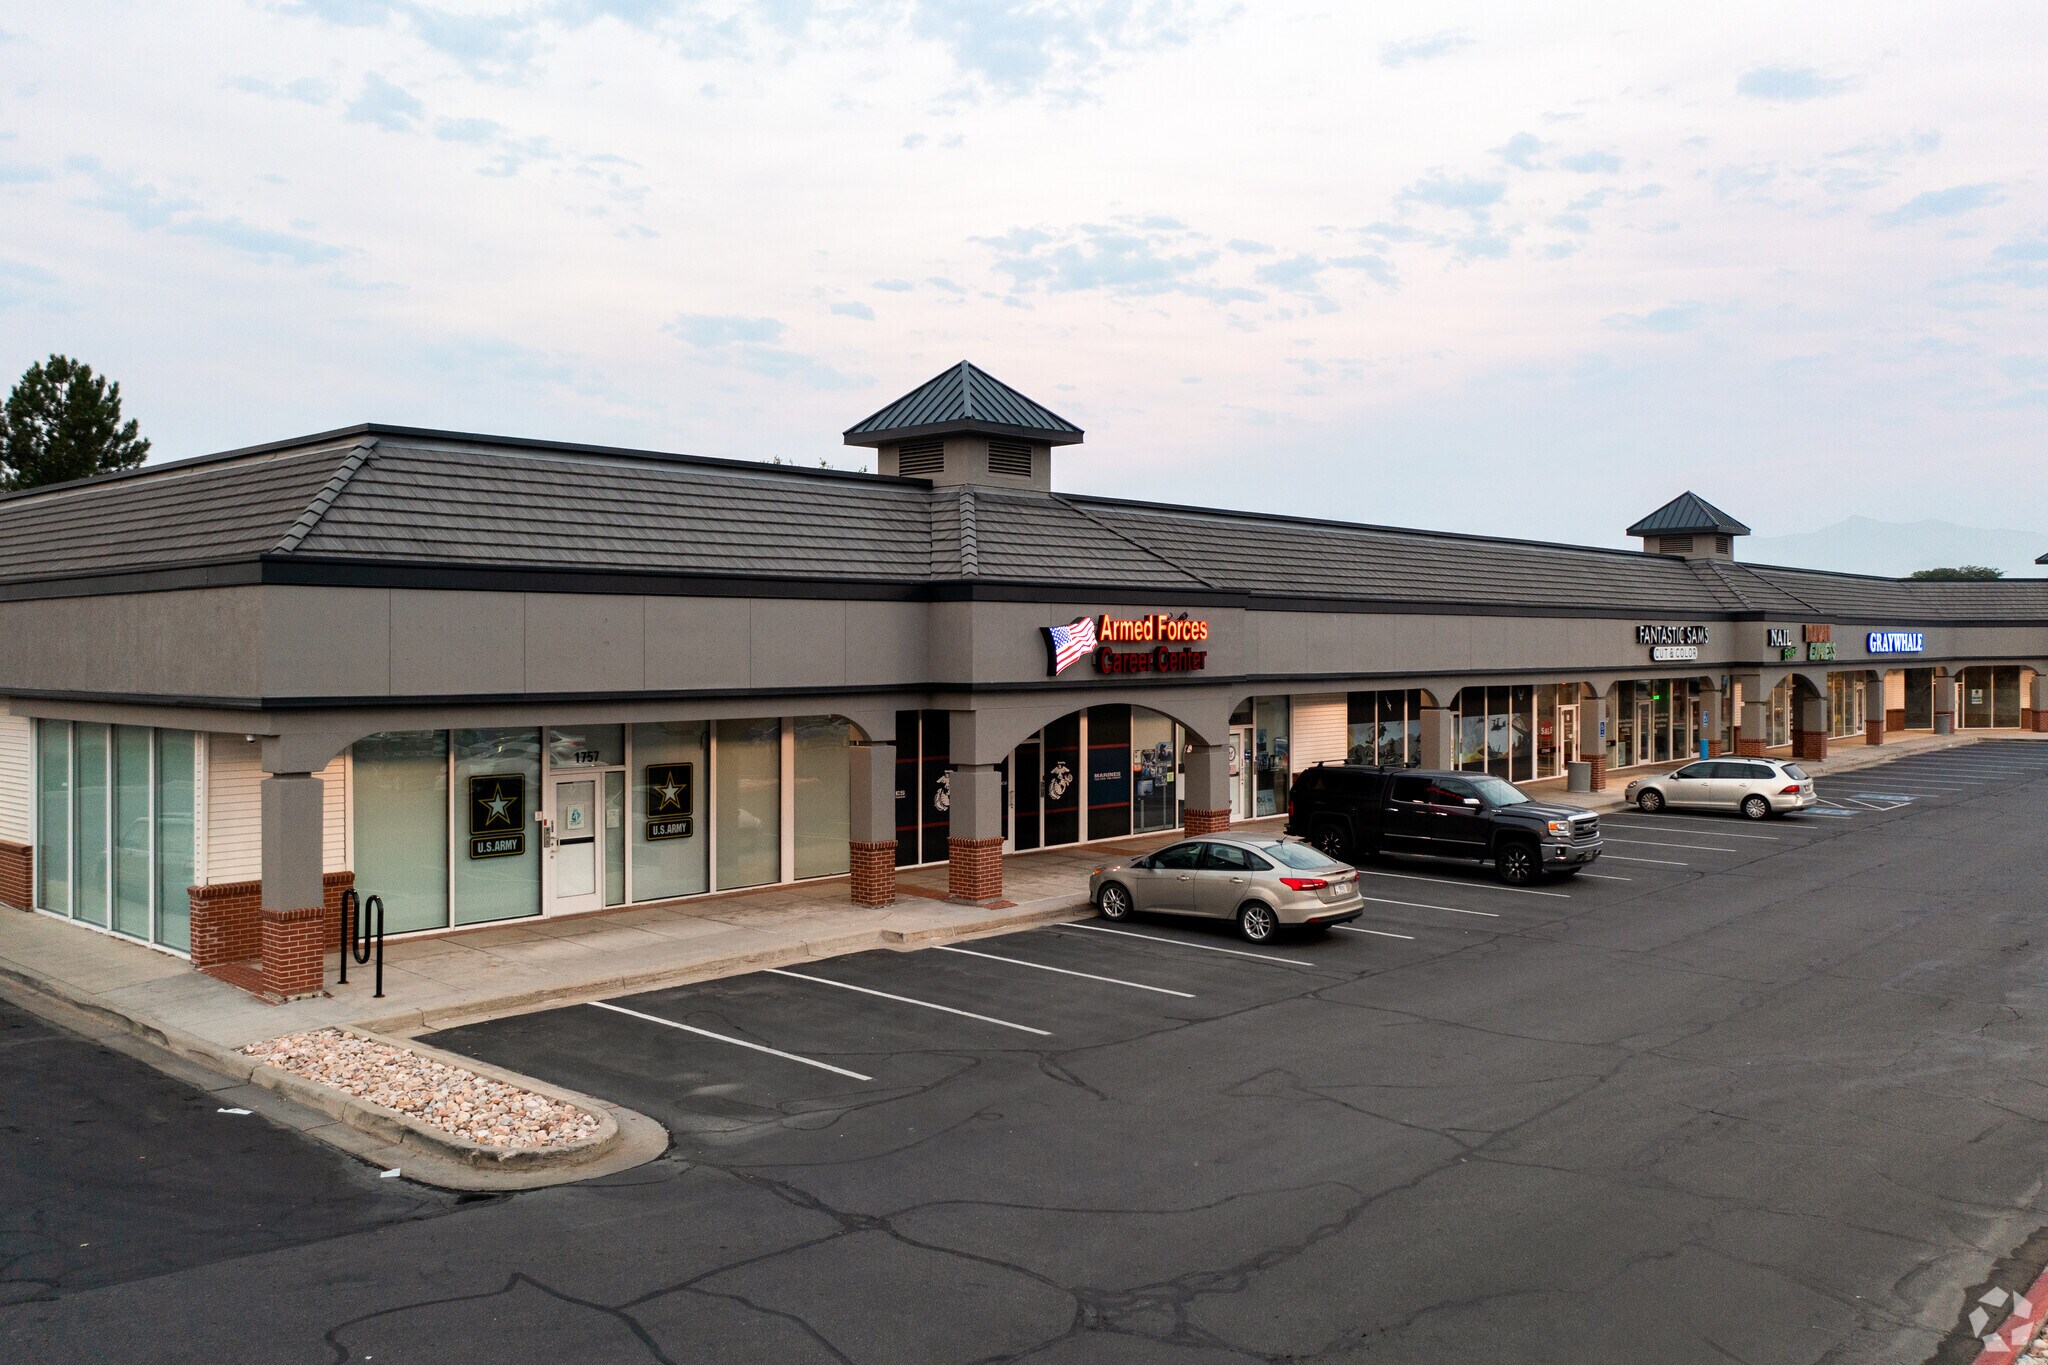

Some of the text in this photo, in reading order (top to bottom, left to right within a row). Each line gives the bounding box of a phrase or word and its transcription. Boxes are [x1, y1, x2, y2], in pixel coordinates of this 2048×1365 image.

[1100, 613, 1208, 642] Armed Forces
[1639, 625, 1709, 644] FANTASTIC SAMS
[1771, 628, 1792, 646] NAIL
[1869, 632, 1923, 653] GRAYWHALE
[1100, 645, 1207, 674] Career Center
[1656, 648, 1668, 659] CUT
[1675, 647, 1697, 658] COLOR
[1540, 726, 1553, 735] SALE
[574, 751, 600, 764] 1757
